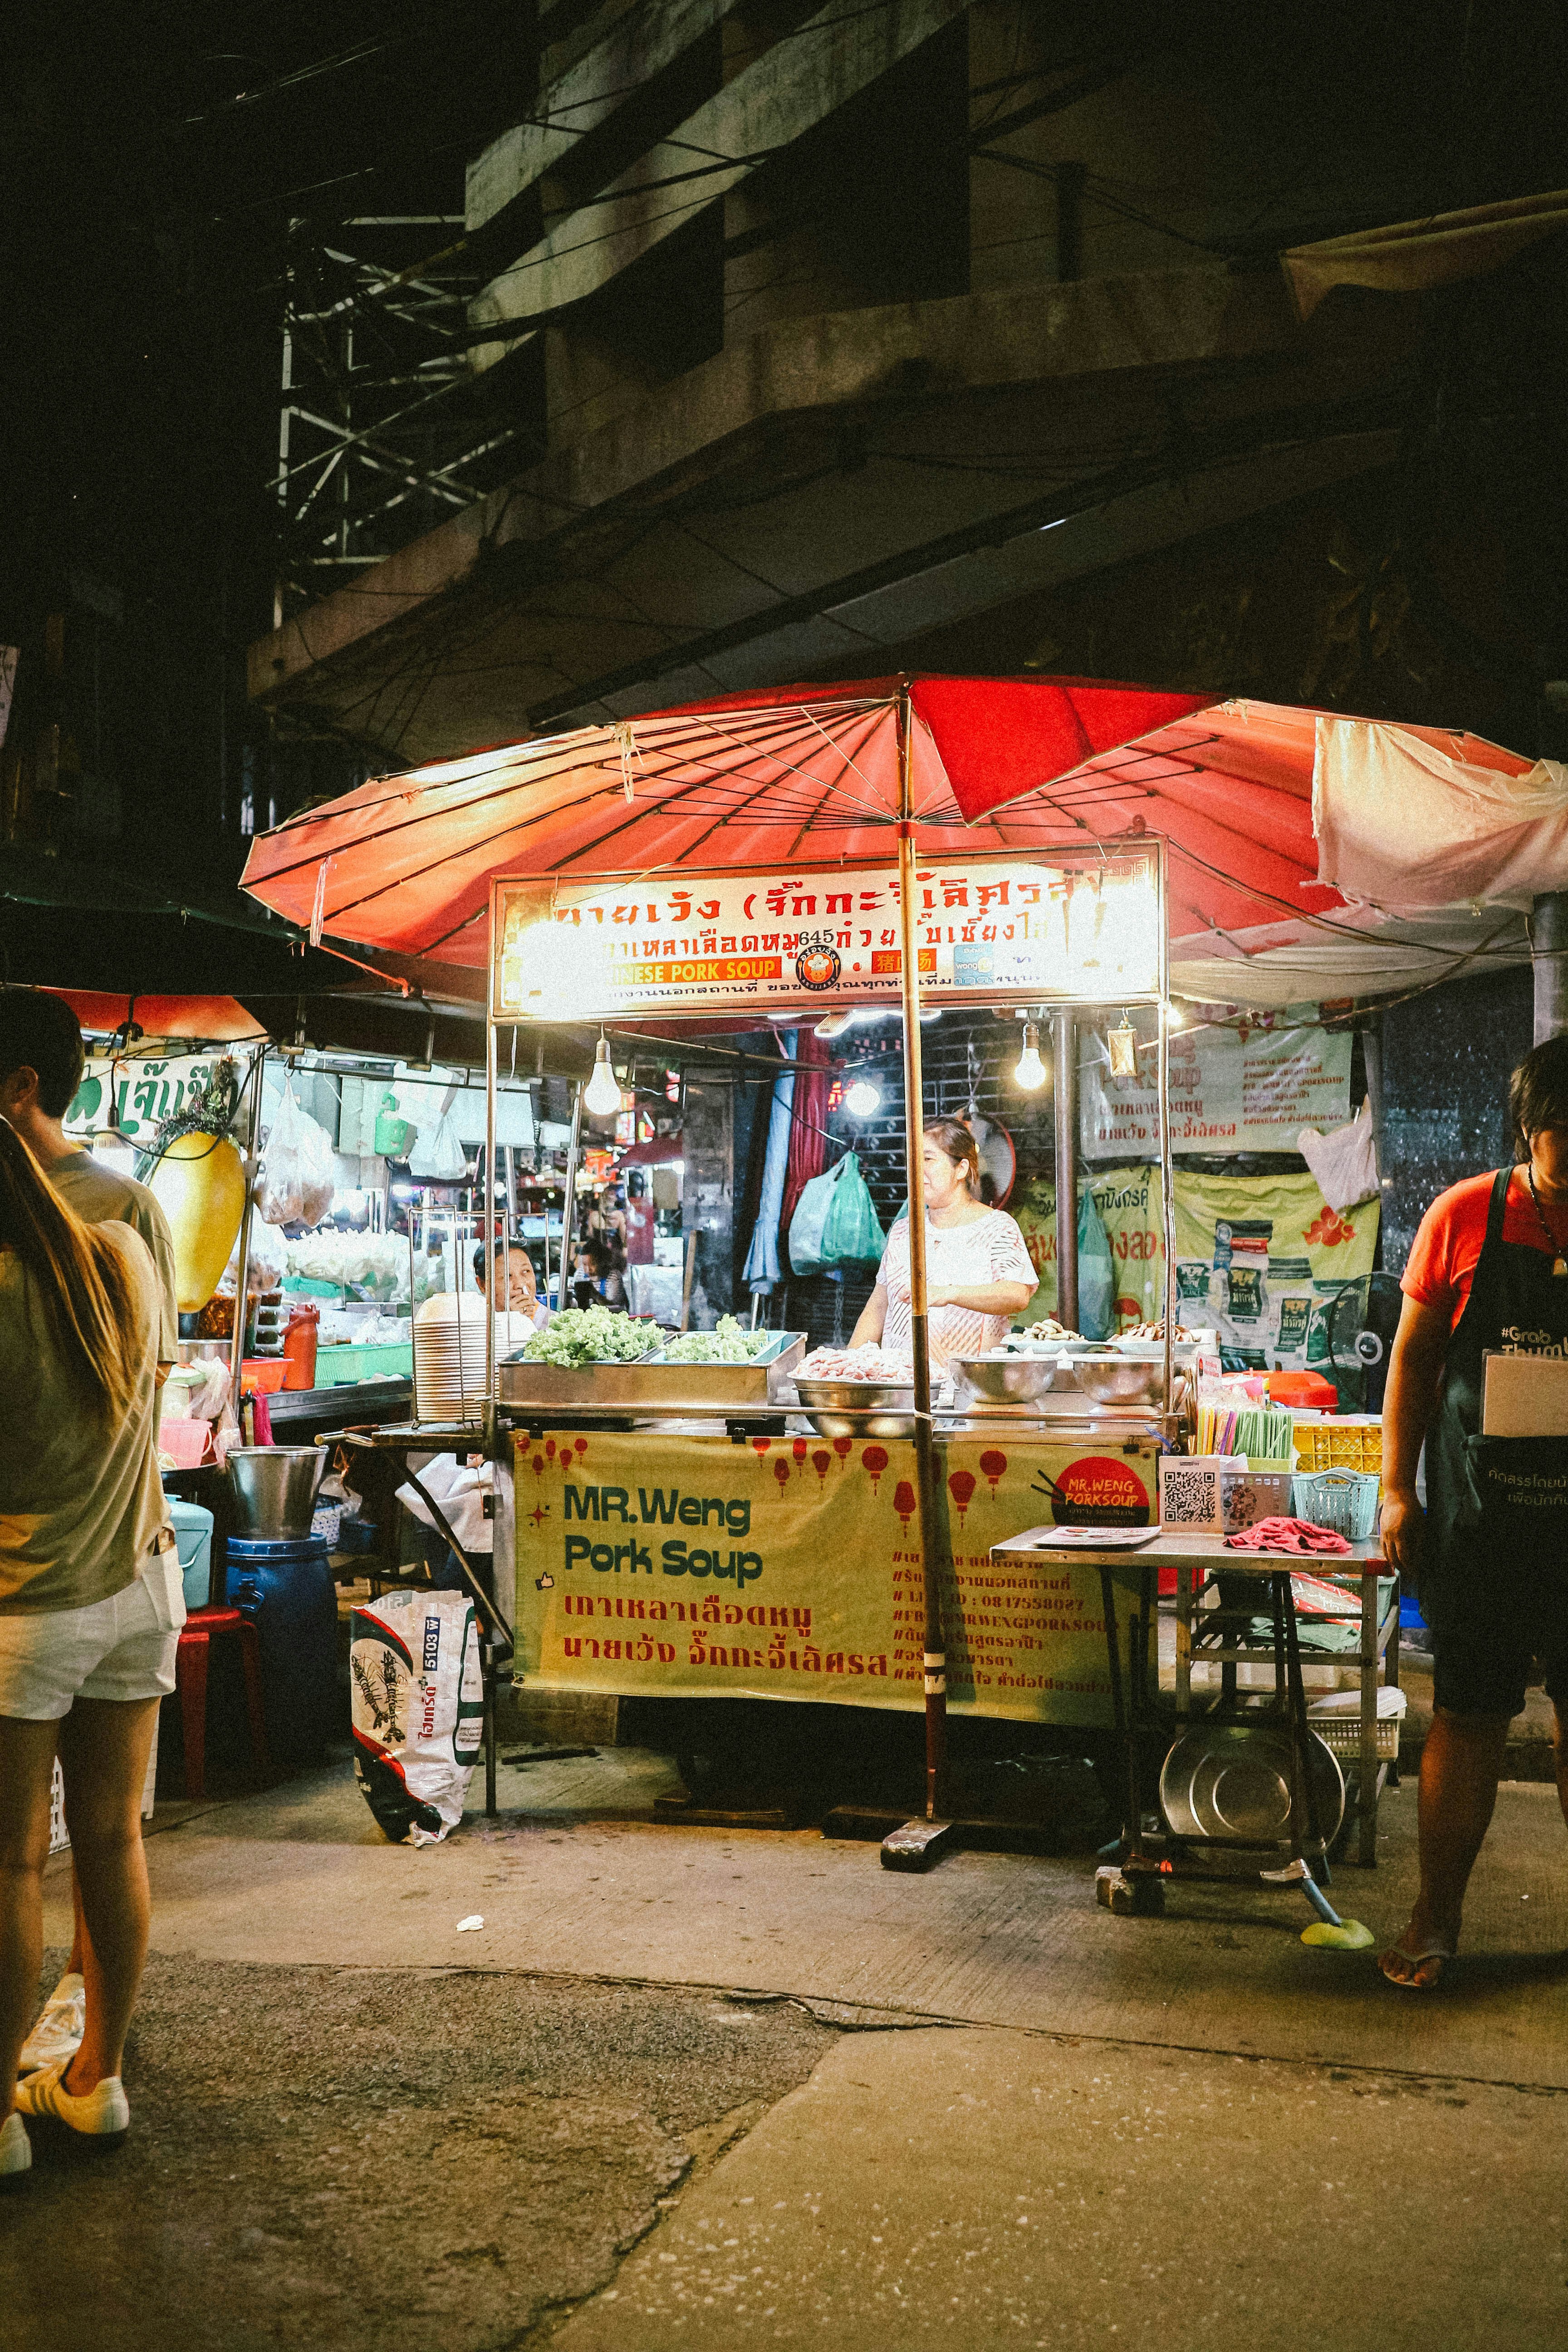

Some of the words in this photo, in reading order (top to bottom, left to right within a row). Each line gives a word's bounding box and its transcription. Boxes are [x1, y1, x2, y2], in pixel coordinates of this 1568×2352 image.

[799, 928, 834, 946] 645
[672, 963, 720, 982] PORK
[726, 960, 775, 979] SOUP
[1501, 1326, 1552, 1344] #Grab
[1068, 1478, 1135, 1494] MR.WENG
[564, 1484, 751, 1537] MR.Weng
[1066, 1492, 1139, 1508] PORKSOUP
[565, 1535, 652, 1574] Pork
[662, 1539, 763, 1588] Soup
[565, 1594, 812, 1637] เกาเหลาเลือดหมู
[425, 1633, 438, 1668] 5103
[564, 1634, 676, 1663] นายเว้ง
